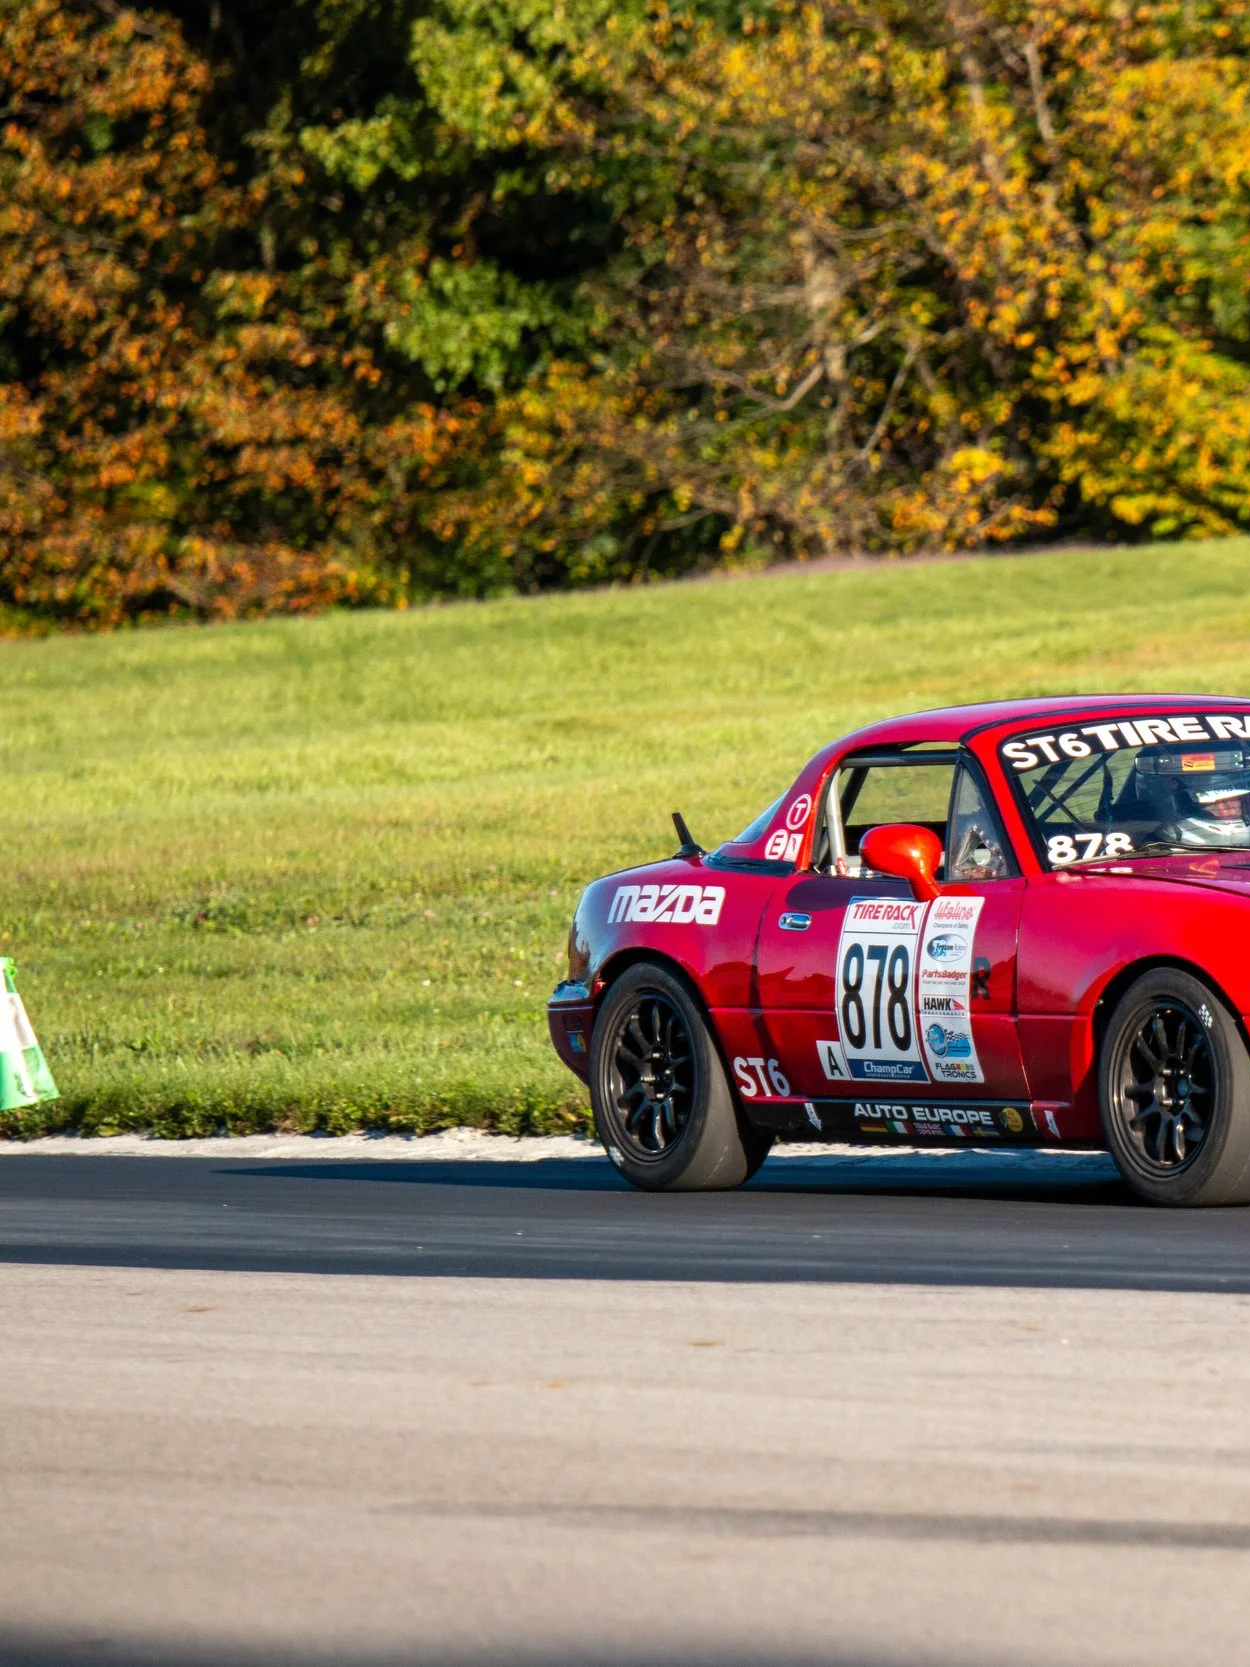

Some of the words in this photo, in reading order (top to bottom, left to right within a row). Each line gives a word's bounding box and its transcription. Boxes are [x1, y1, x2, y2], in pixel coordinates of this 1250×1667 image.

[1002, 732, 1092, 769] ST6
[1080, 716, 1204, 751] TIRE
[793, 803, 807, 822] T
[768, 834, 785, 855] E
[1048, 832, 1134, 864] 878
[853, 904, 885, 920] TIRE
[881, 905, 919, 929] RACK
[922, 969, 967, 981] PartsBadger
[972, 956, 991, 1000] R
[842, 943, 911, 1051] 878
[923, 997, 952, 1010] HAWK
[827, 1045, 844, 1077] A
[863, 1061, 913, 1078] ChampCar
[935, 1062, 956, 1070] FLAG
[733, 1056, 791, 1097] ST6
[941, 1070, 976, 1079] TRONICS
[854, 1102, 908, 1121] AUTO
[912, 1107, 994, 1125] EUROPE
